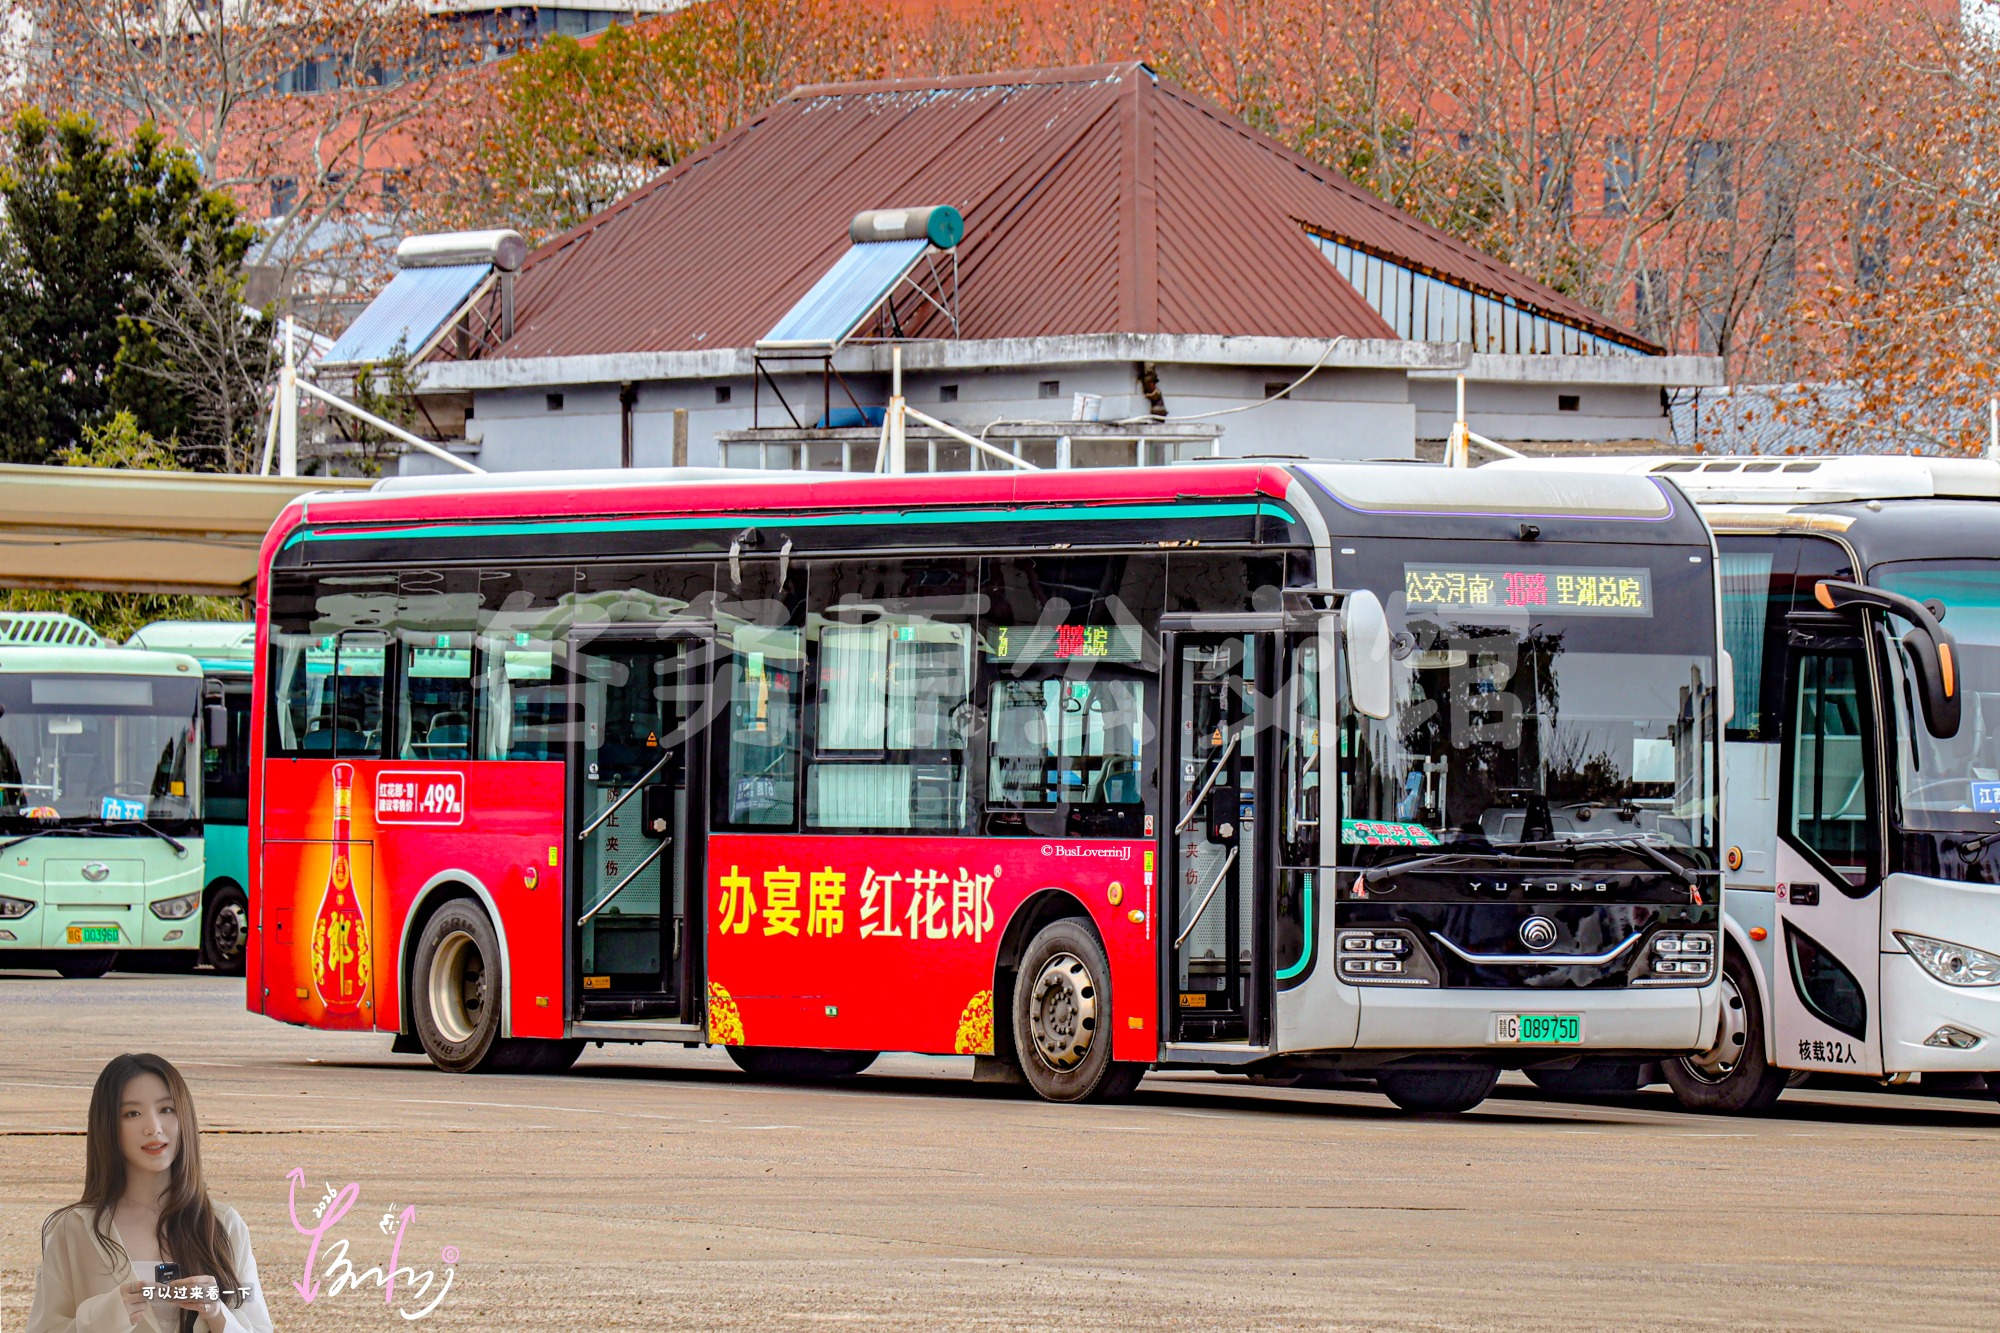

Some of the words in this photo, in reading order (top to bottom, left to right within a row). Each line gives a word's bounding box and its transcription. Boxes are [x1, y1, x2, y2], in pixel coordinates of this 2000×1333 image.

[1405, 571, 1494, 604] 公交浔南
[718, 865, 847, 938] 办宴席
[1469, 882, 1607, 892] YUTONG
[1799, 1039, 1857, 1065] 核载32人
